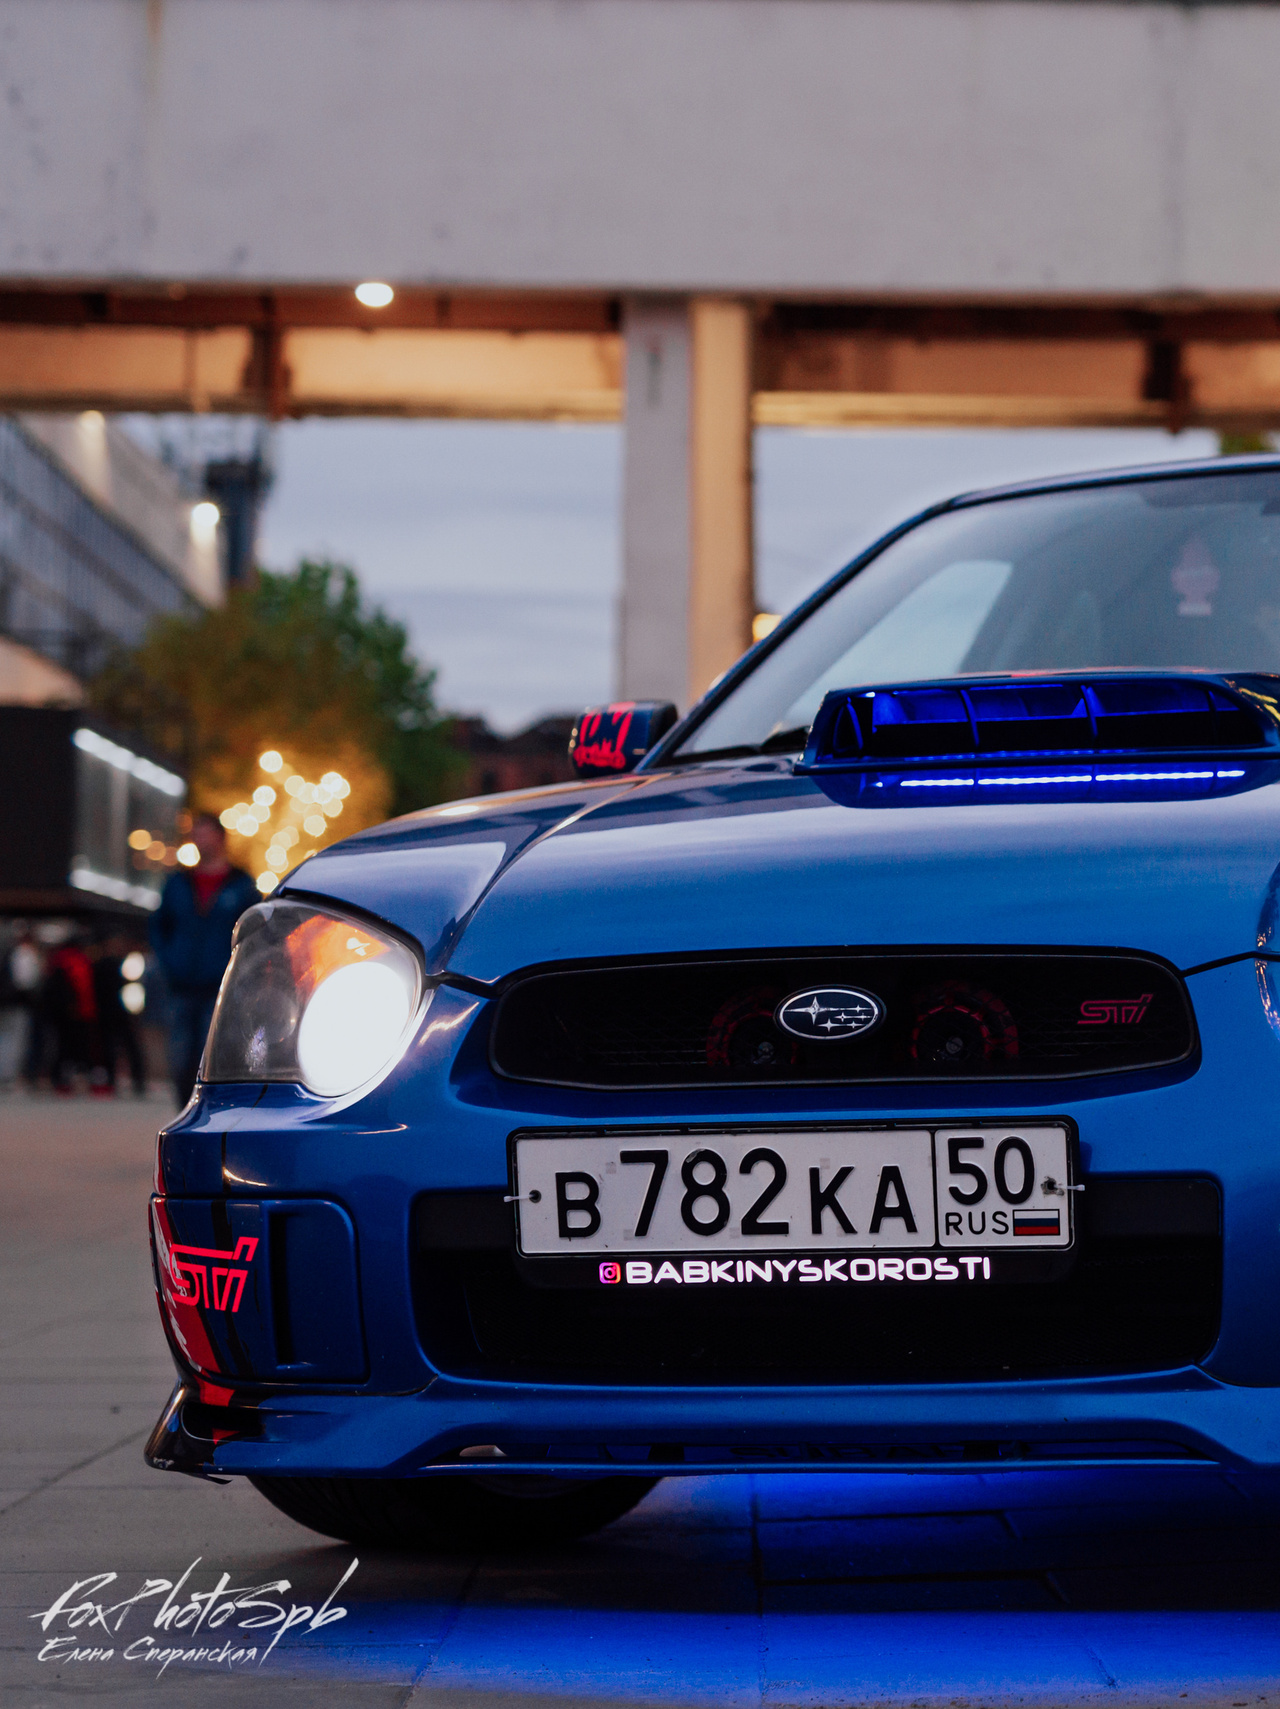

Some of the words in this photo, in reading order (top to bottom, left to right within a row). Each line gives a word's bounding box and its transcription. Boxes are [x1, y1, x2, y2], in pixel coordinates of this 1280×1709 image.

[946, 1135, 1036, 1206] 50
[944, 1209, 1010, 1237] RUS
[625, 1256, 991, 1285] BABKINYSKOROSTI
